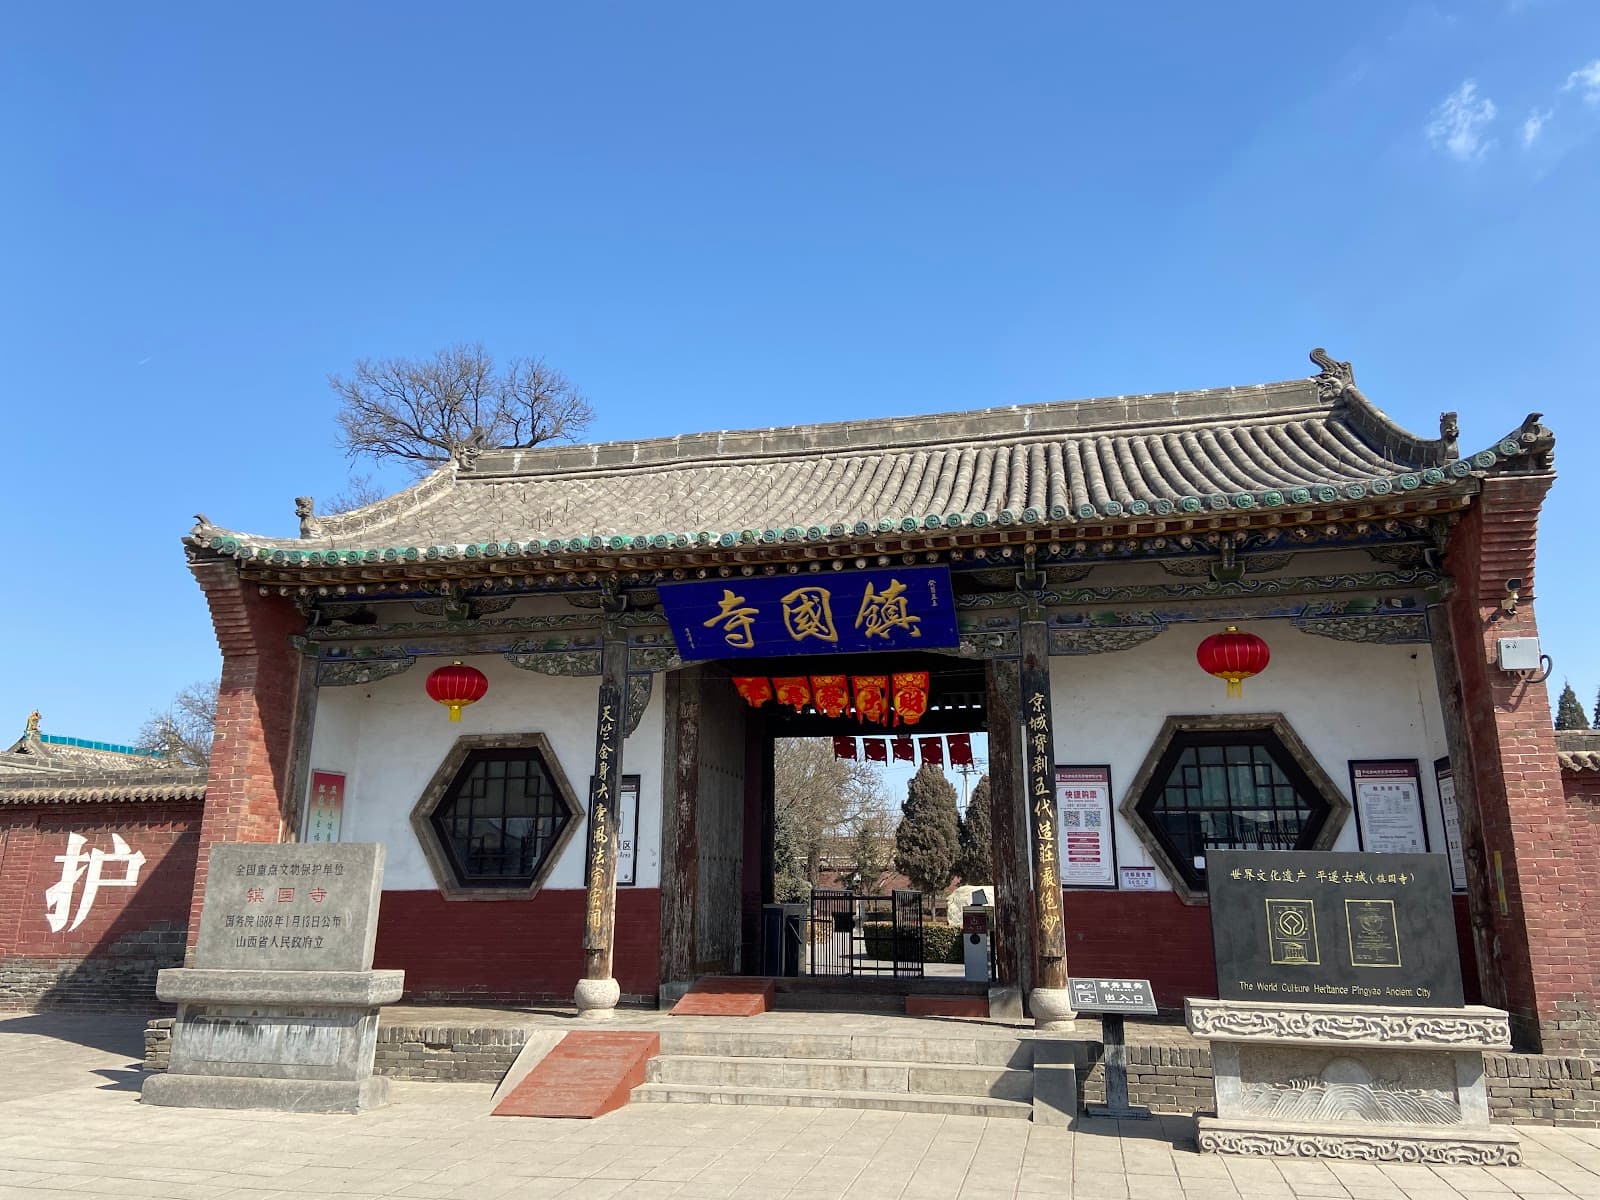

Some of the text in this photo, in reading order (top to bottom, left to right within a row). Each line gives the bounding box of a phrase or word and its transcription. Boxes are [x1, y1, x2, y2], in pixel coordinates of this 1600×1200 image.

[235, 863, 345, 876] 全国重点文物保护单位
[44, 831, 147, 933] 护
[235, 935, 324, 949] 山西省人民政府立
[1239, 981, 1253, 991] The
[1256, 982, 1278, 992] World
[1281, 983, 1310, 993] Culture
[1351, 985, 1382, 997] Pingyao
[1385, 986, 1413, 997] Ancient
[1416, 987, 1431, 998] City
[1104, 993, 1144, 1002] 出入口
